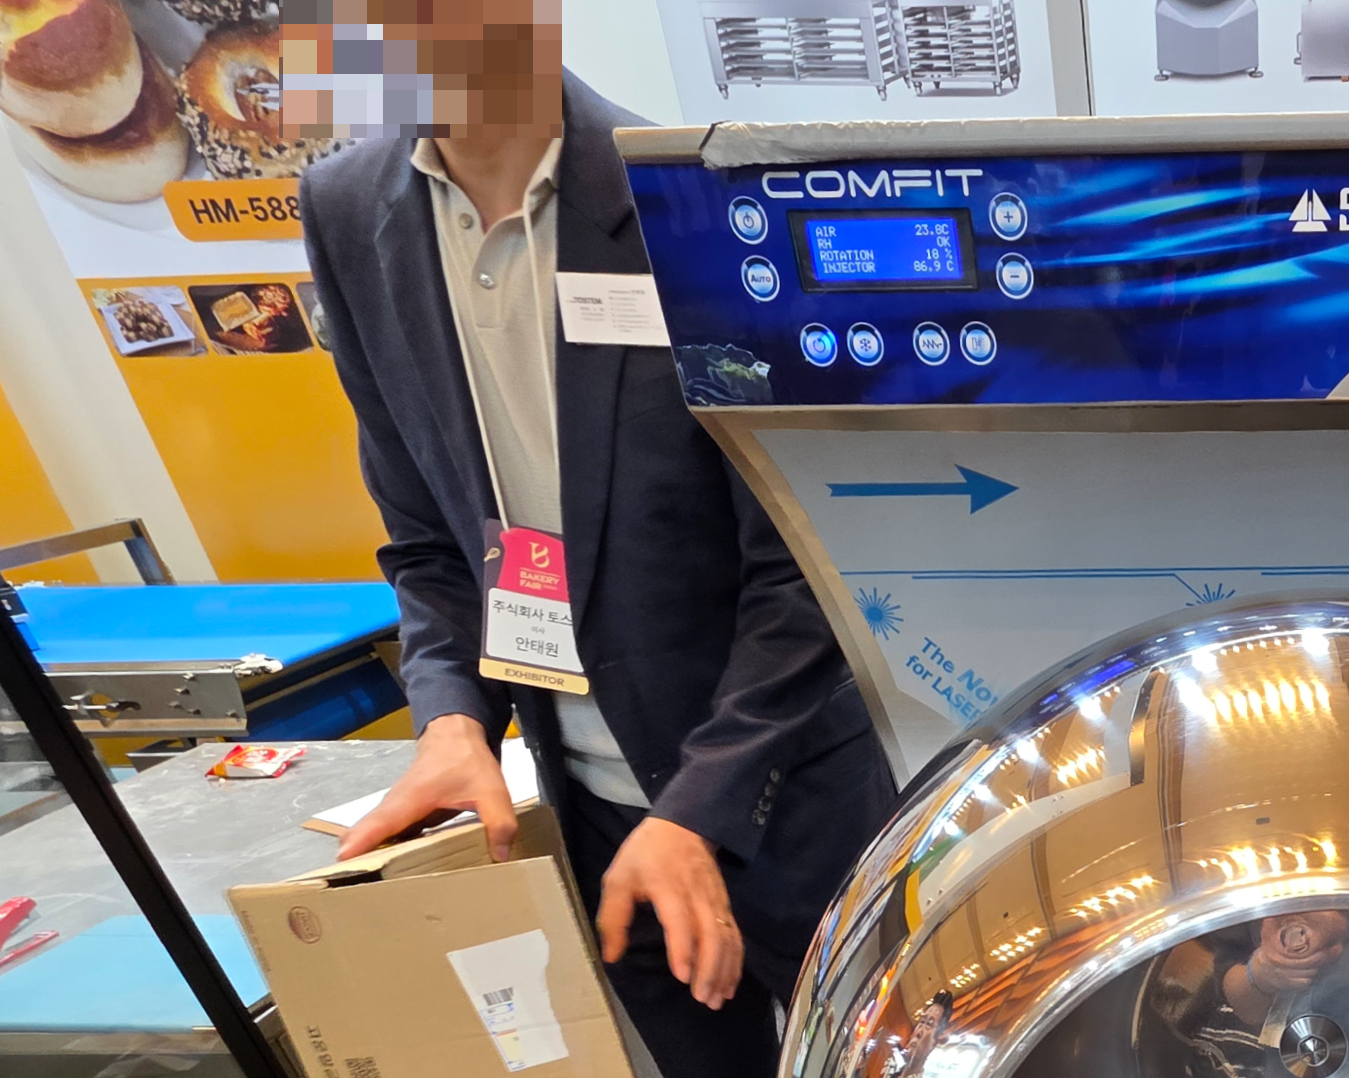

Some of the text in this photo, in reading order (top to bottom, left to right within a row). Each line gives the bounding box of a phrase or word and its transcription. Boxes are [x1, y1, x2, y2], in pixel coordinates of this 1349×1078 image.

[761, 168, 984, 199] COMFIT
[815, 225, 837, 238] AIR
[817, 235, 951, 250] RH OK
[819, 248, 954, 262] ROTATION 18 %
[822, 260, 955, 274] INJECTOR 86.9 C
[519, 570, 561, 586] BAKERY
[519, 578, 543, 591] FAIR
[492, 599, 544, 622] 주식회사
[515, 637, 559, 657] 안태원
[921, 636, 956, 674] The
[905, 655, 934, 681] for
[504, 668, 565, 686] EXHIBITOR
